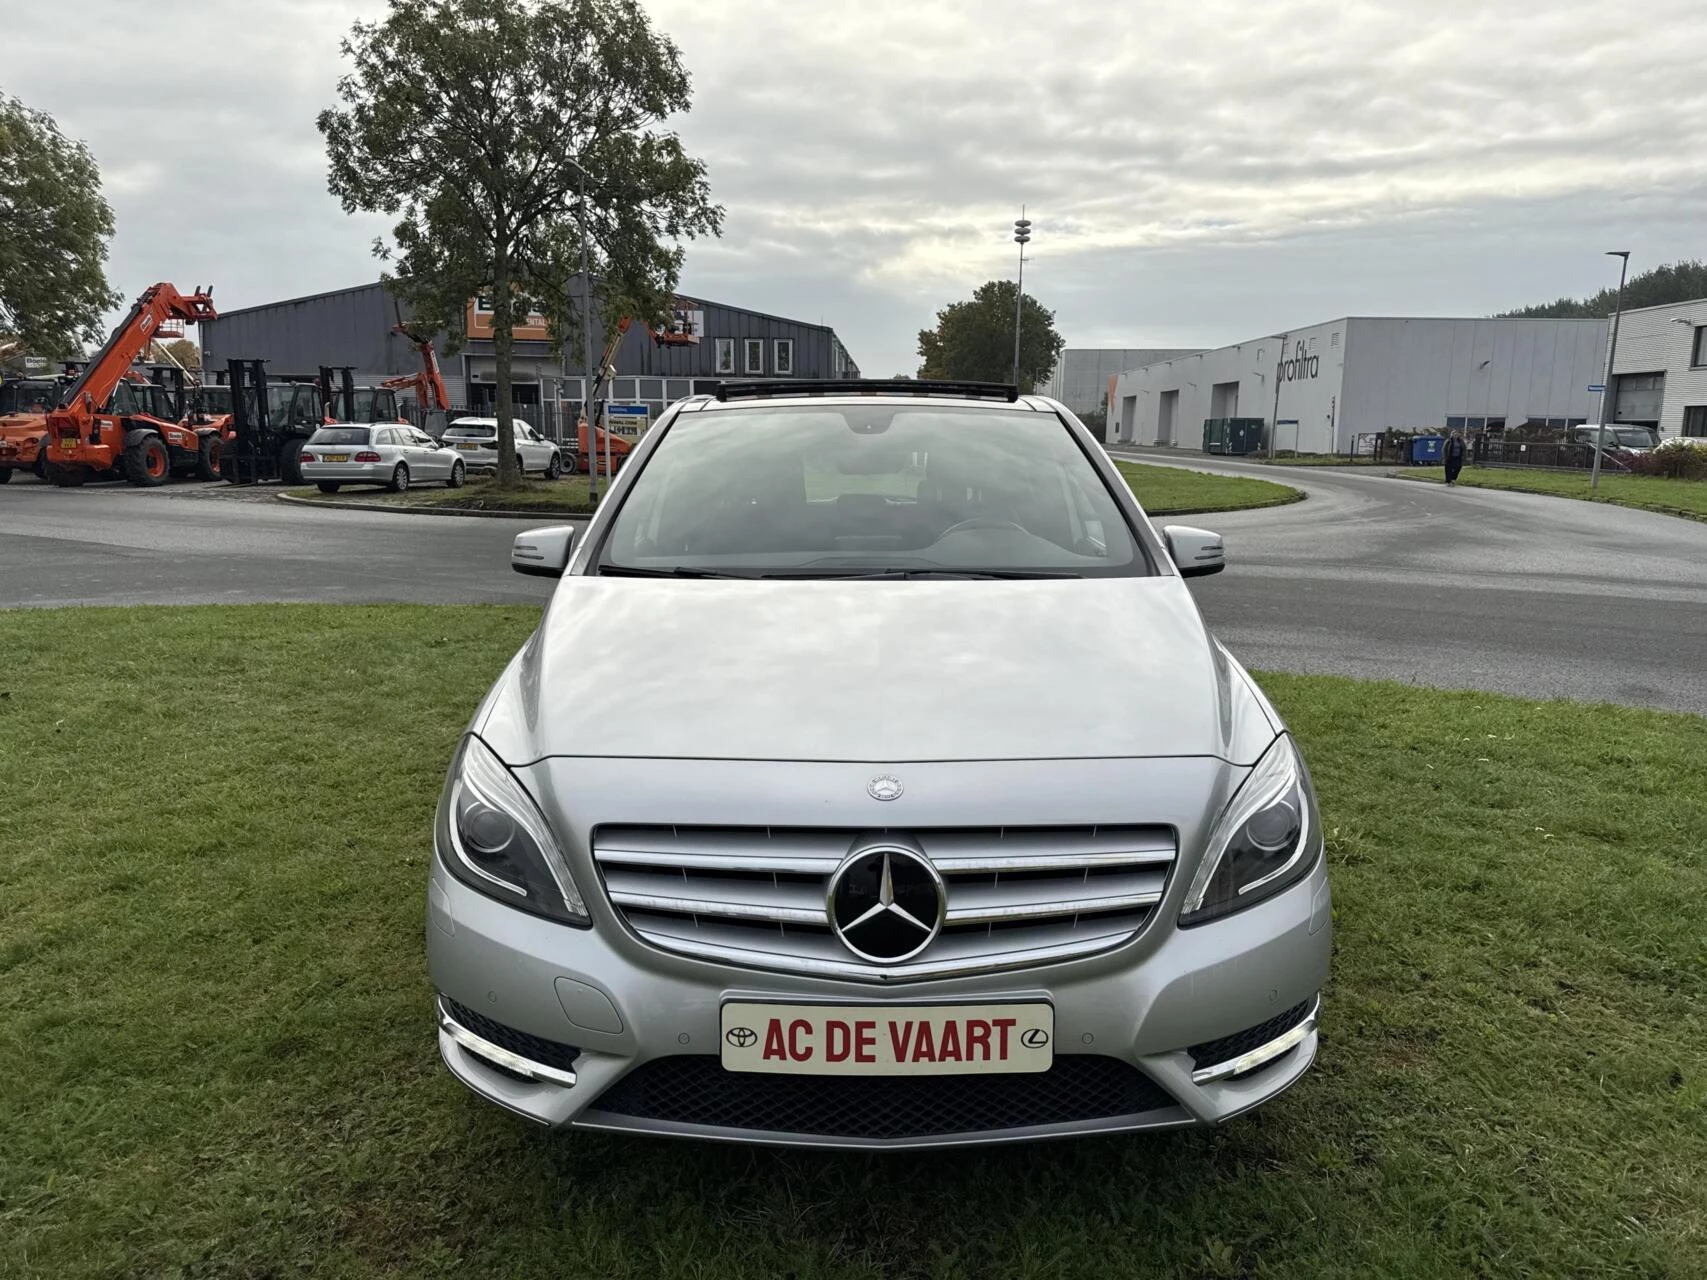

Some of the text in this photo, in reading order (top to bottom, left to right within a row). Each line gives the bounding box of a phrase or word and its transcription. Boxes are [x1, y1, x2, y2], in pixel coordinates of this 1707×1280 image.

[1277, 340, 1319, 383] profiltra
[762, 1018, 1017, 1063] AC DE VAART
